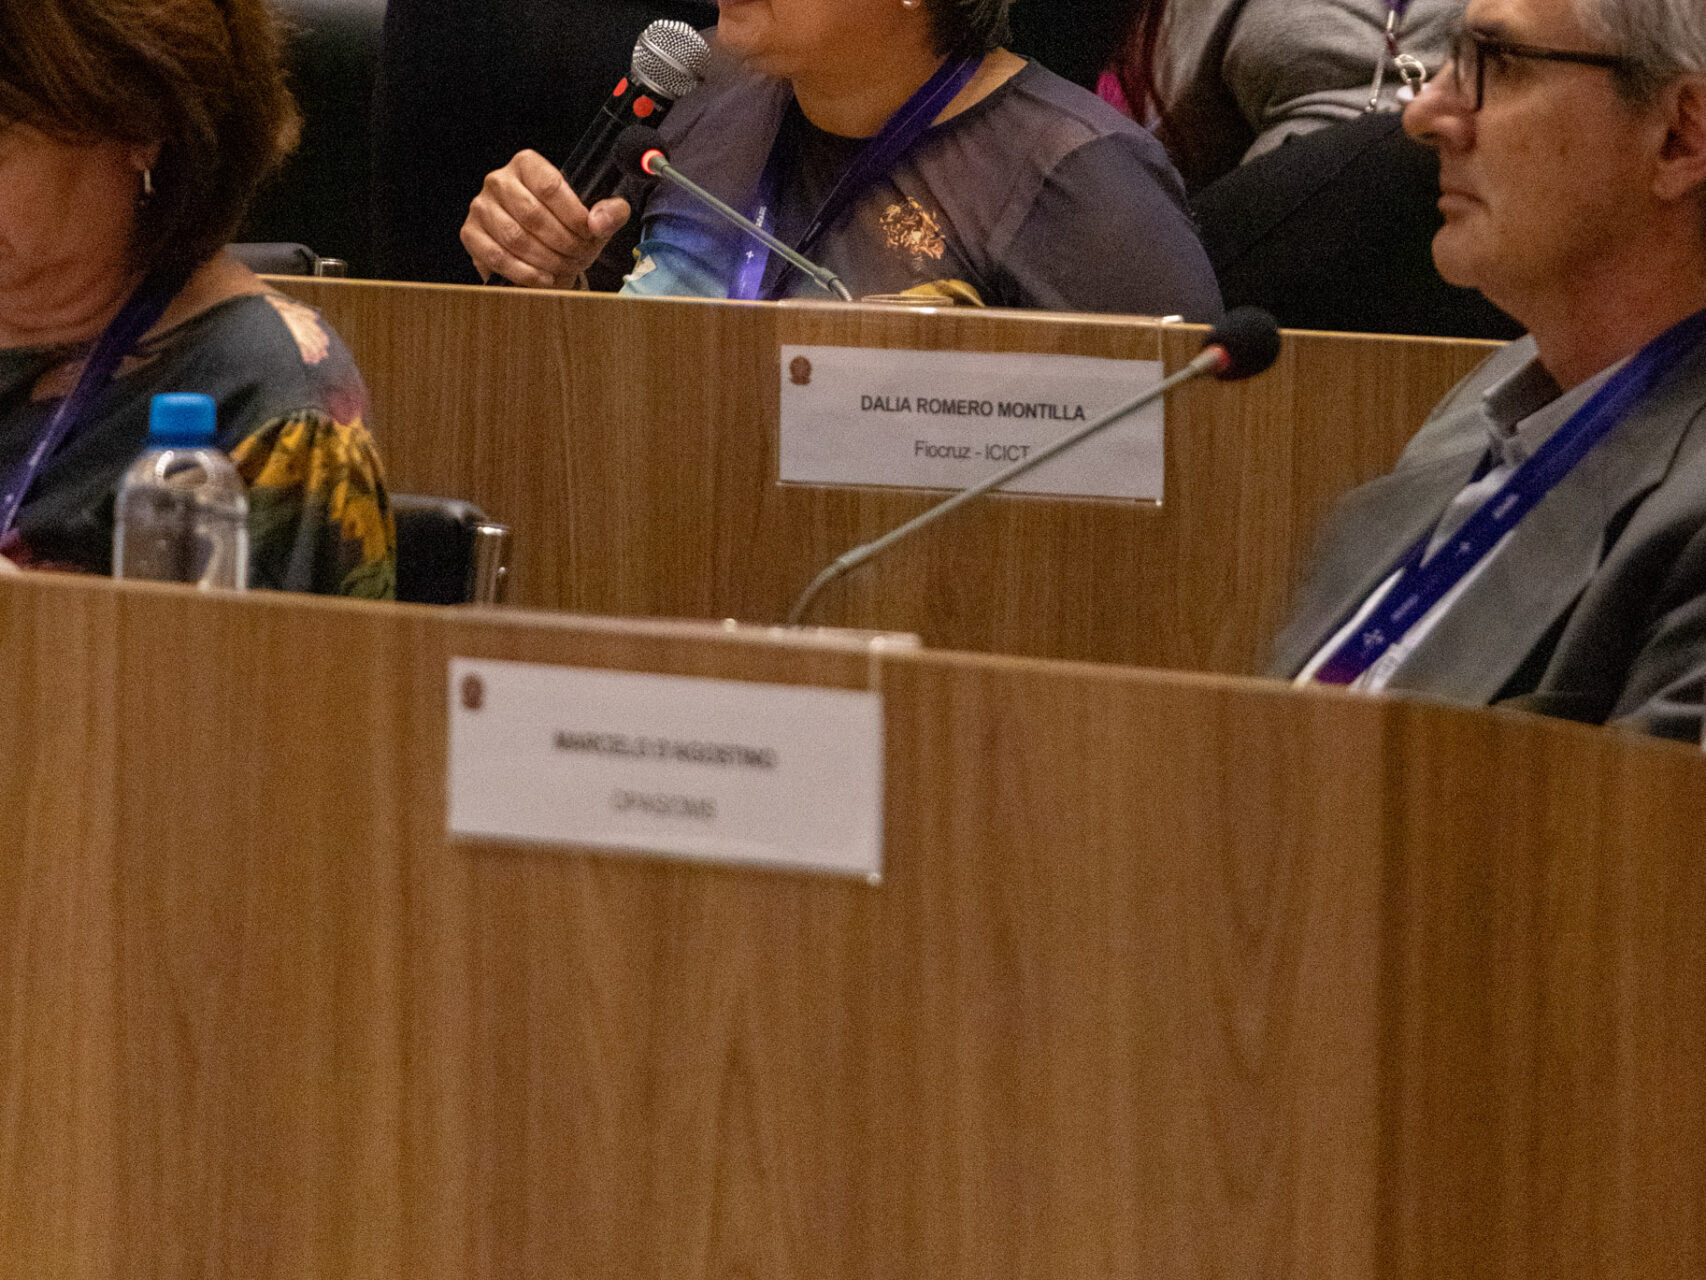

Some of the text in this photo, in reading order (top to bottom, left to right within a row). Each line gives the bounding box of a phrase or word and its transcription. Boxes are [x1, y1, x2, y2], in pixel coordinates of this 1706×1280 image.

[860, 395, 1086, 421] DALIA ROMERO MONTILLA
[914, 439, 972, 460] Fiocruz
[985, 442, 1031, 462] ICICT
